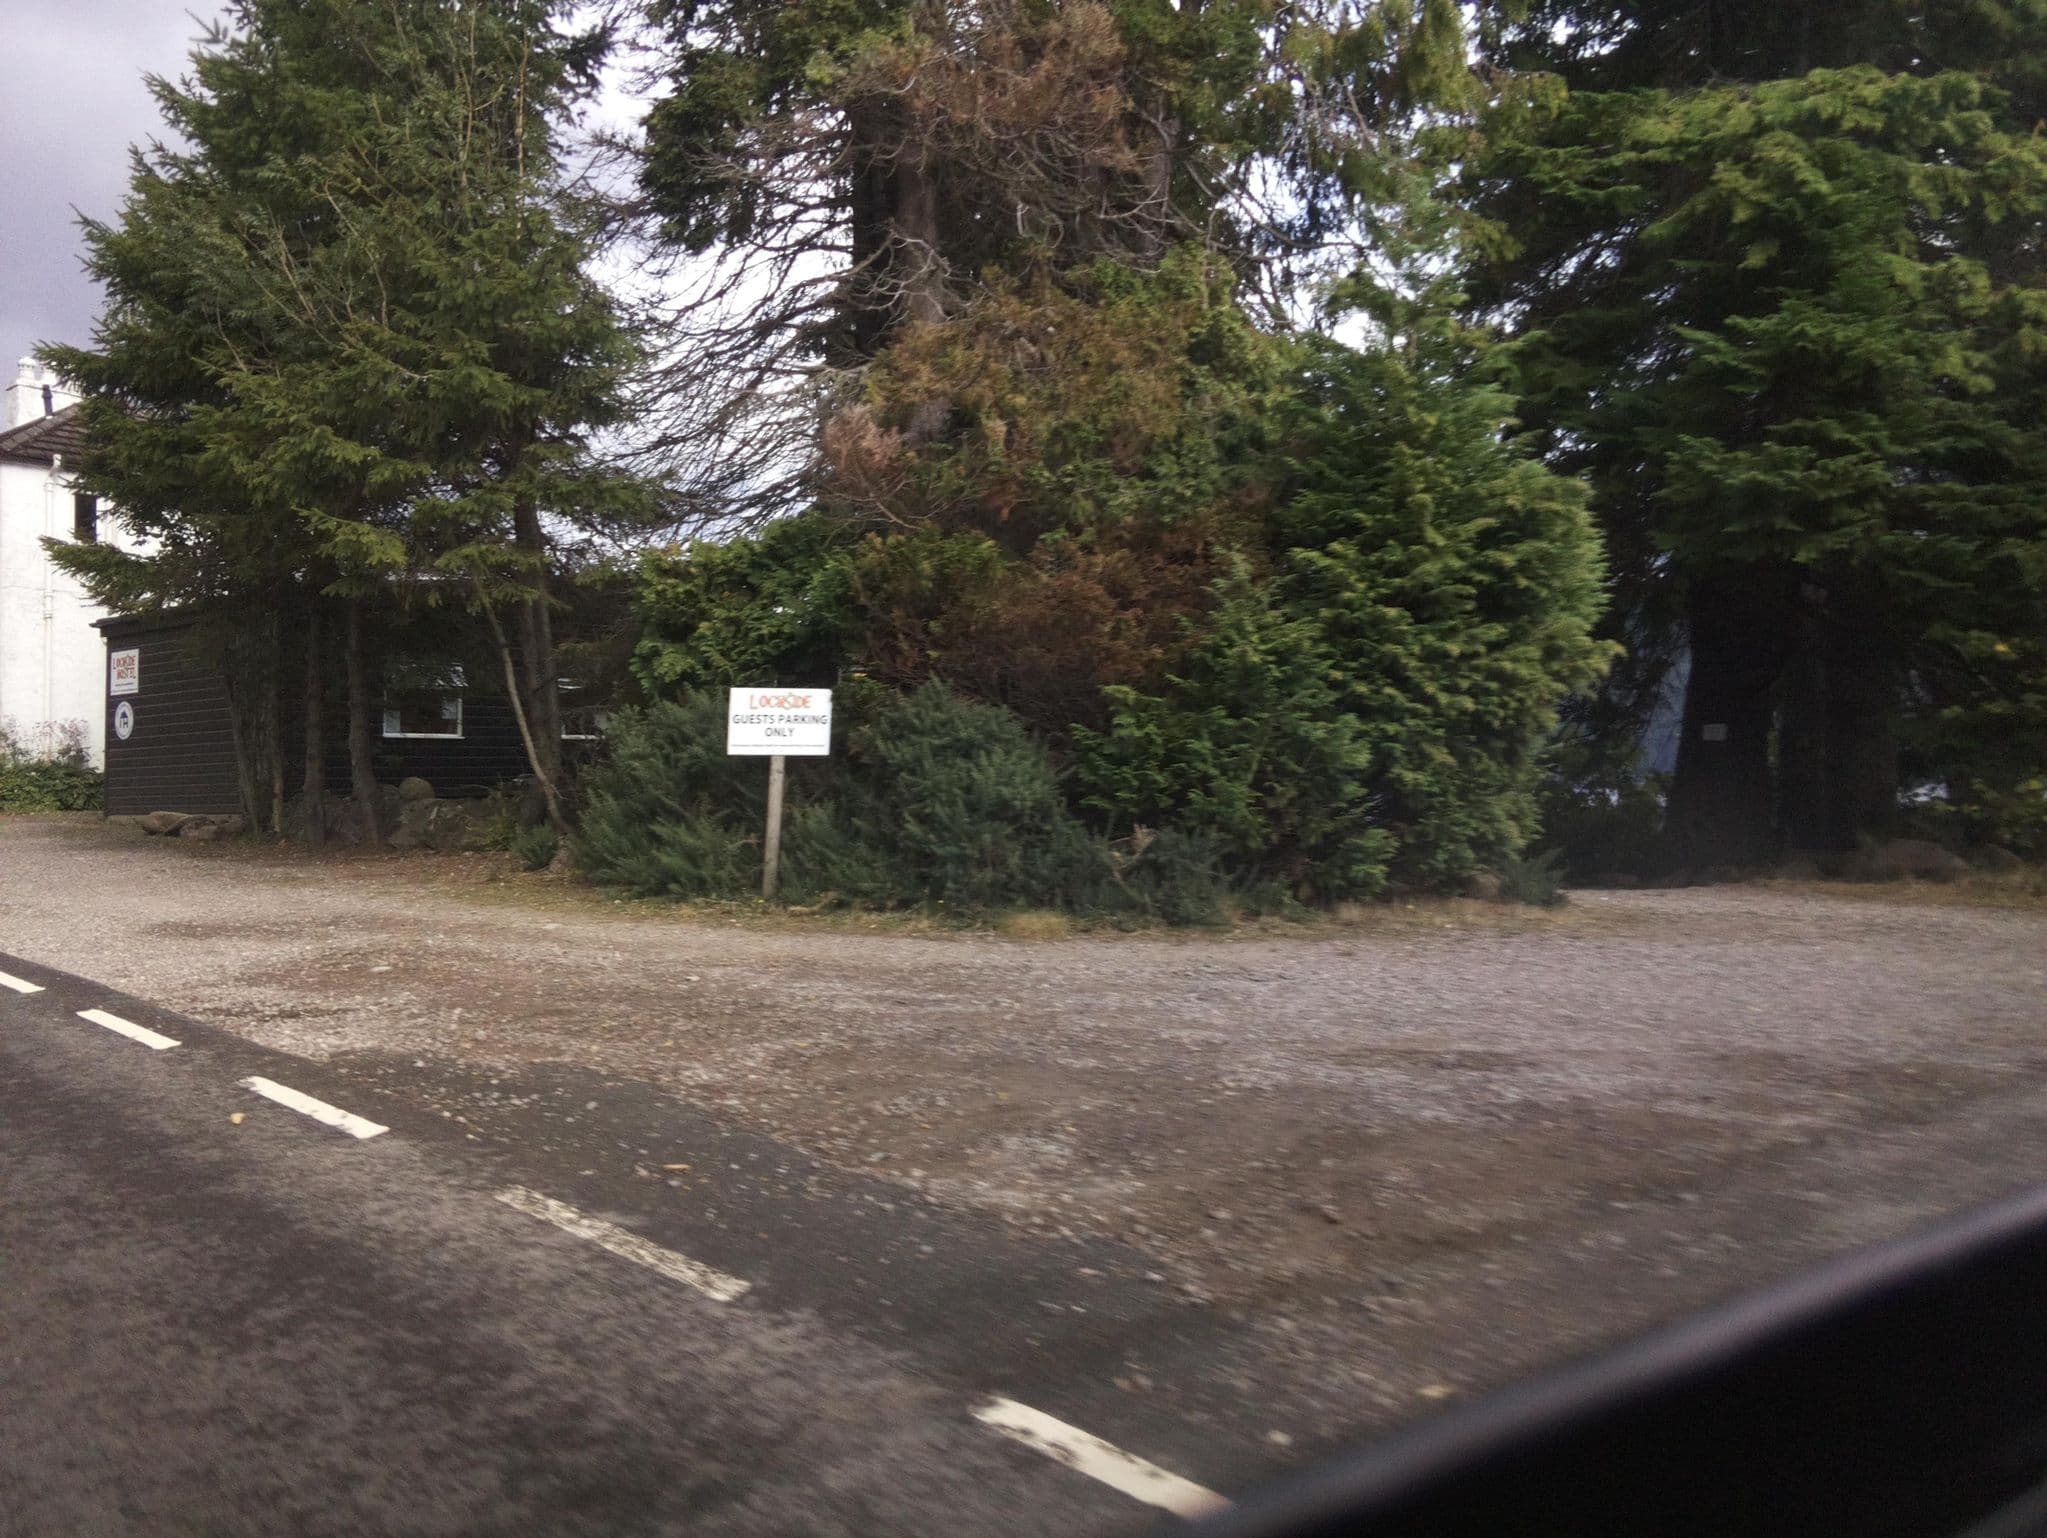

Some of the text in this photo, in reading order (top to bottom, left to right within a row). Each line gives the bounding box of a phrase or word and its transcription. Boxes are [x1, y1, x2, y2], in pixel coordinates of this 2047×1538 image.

[733, 714, 828, 725] GUESTS PARKING
[764, 727, 795, 737] ONLY
